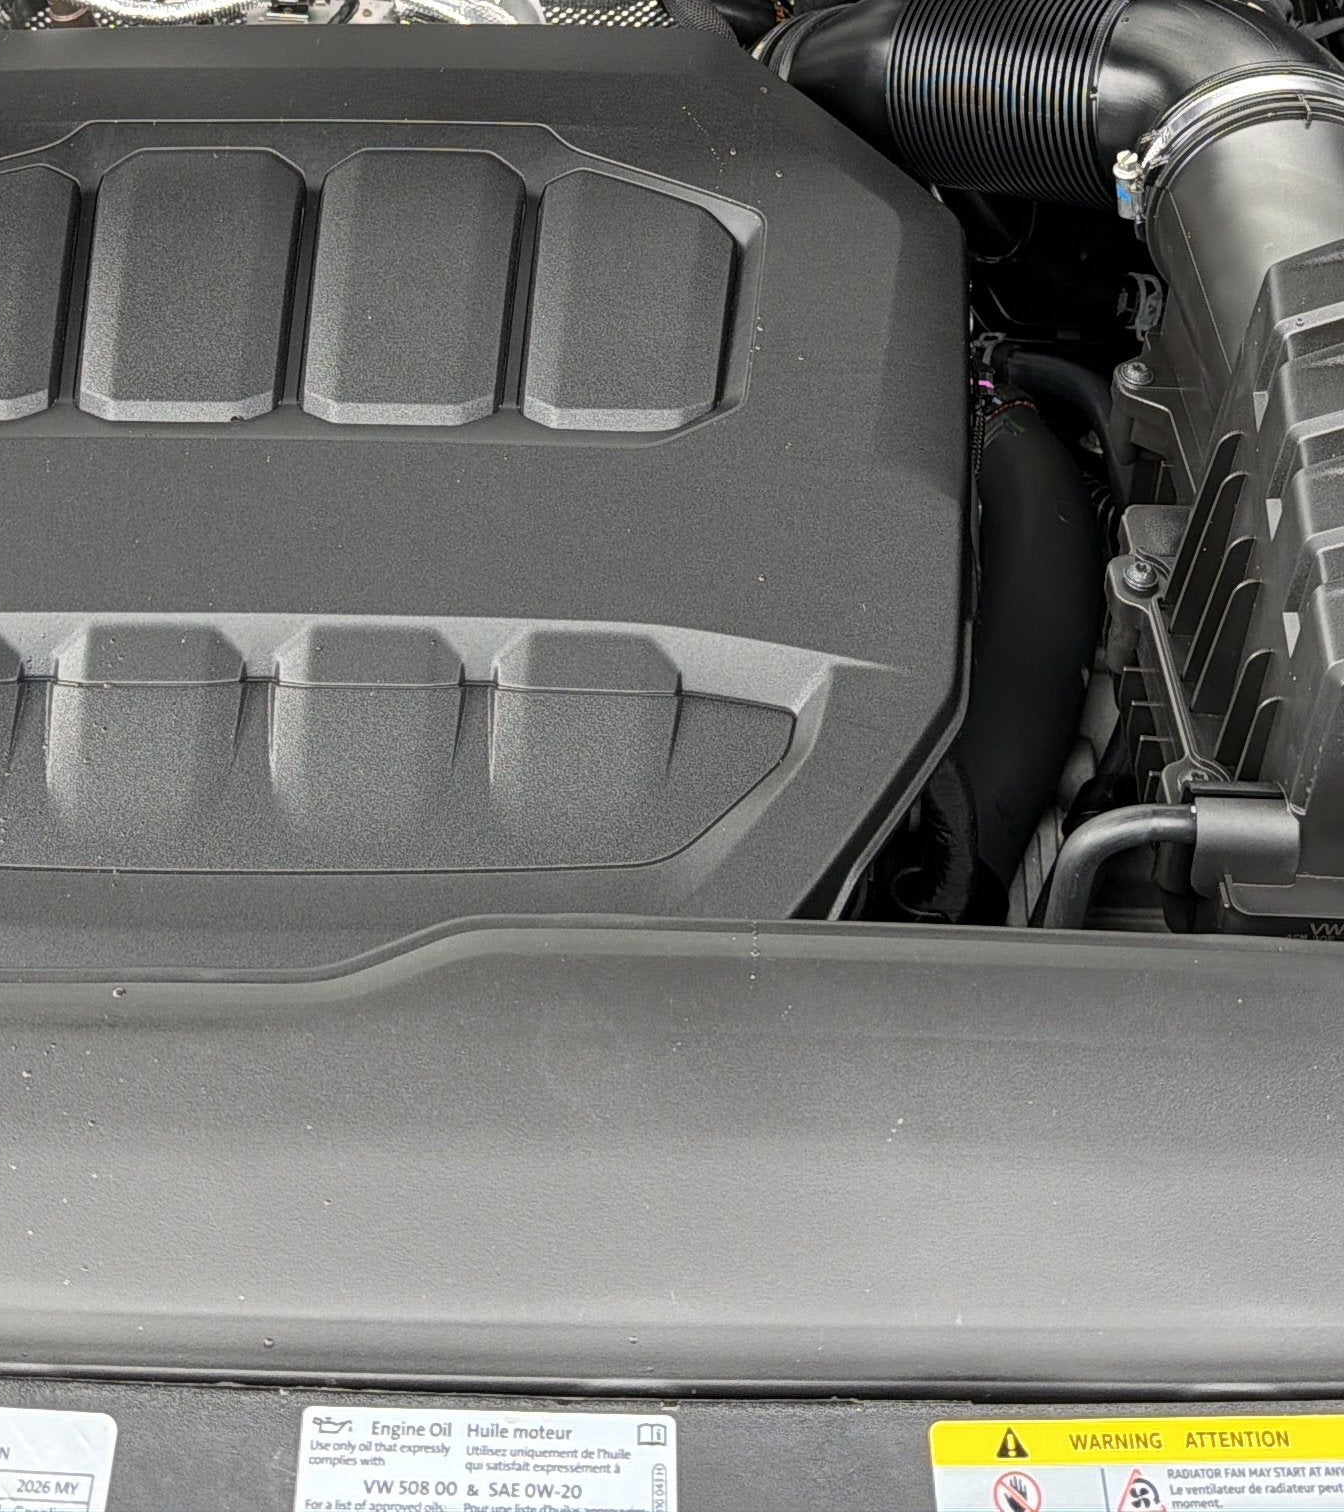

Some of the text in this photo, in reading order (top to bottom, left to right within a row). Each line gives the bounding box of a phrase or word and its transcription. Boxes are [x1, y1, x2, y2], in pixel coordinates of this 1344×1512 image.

[371, 1420, 453, 1441] Engine Oil
[466, 1422, 573, 1441] Huile moteur
[309, 1440, 452, 1457] Use only oil that expressly
[1068, 1430, 1290, 1451] WARNING ATTENTION
[466, 1444, 508, 1457] Utilisez
[509, 1445, 579, 1461] uniquement
[580, 1447, 596, 1460] de
[308, 1455, 386, 1468] complies with
[464, 1460, 621, 1476] qui satisfait expressément à
[1167, 1468, 1222, 1479] RADIATOR
[1224, 1467, 1246, 1479] FAN
[1248, 1467, 1271, 1478] MAY
[1273, 1466, 1307, 1478] START
[1308, 1466, 1322, 1477] AT
[16, 1478, 51, 1495] 2026
[54, 1481, 80, 1496] MY
[362, 1479, 583, 1499] VW 508 00 & SAE 0W-20
[1169, 1484, 1184, 1496] Le
[1185, 1483, 1246, 1496] ventilateur
[1248, 1483, 1262, 1495] de
[1264, 1482, 1315, 1494] radiateur
[1317, 1482, 1344, 1496] peut
[304, 1499, 323, 1510] For
[325, 1501, 333, 1510] a
[334, 1499, 352, 1510] list
[354, 1499, 368, 1511] of
[1171, 1498, 1224, 1510] moment.
